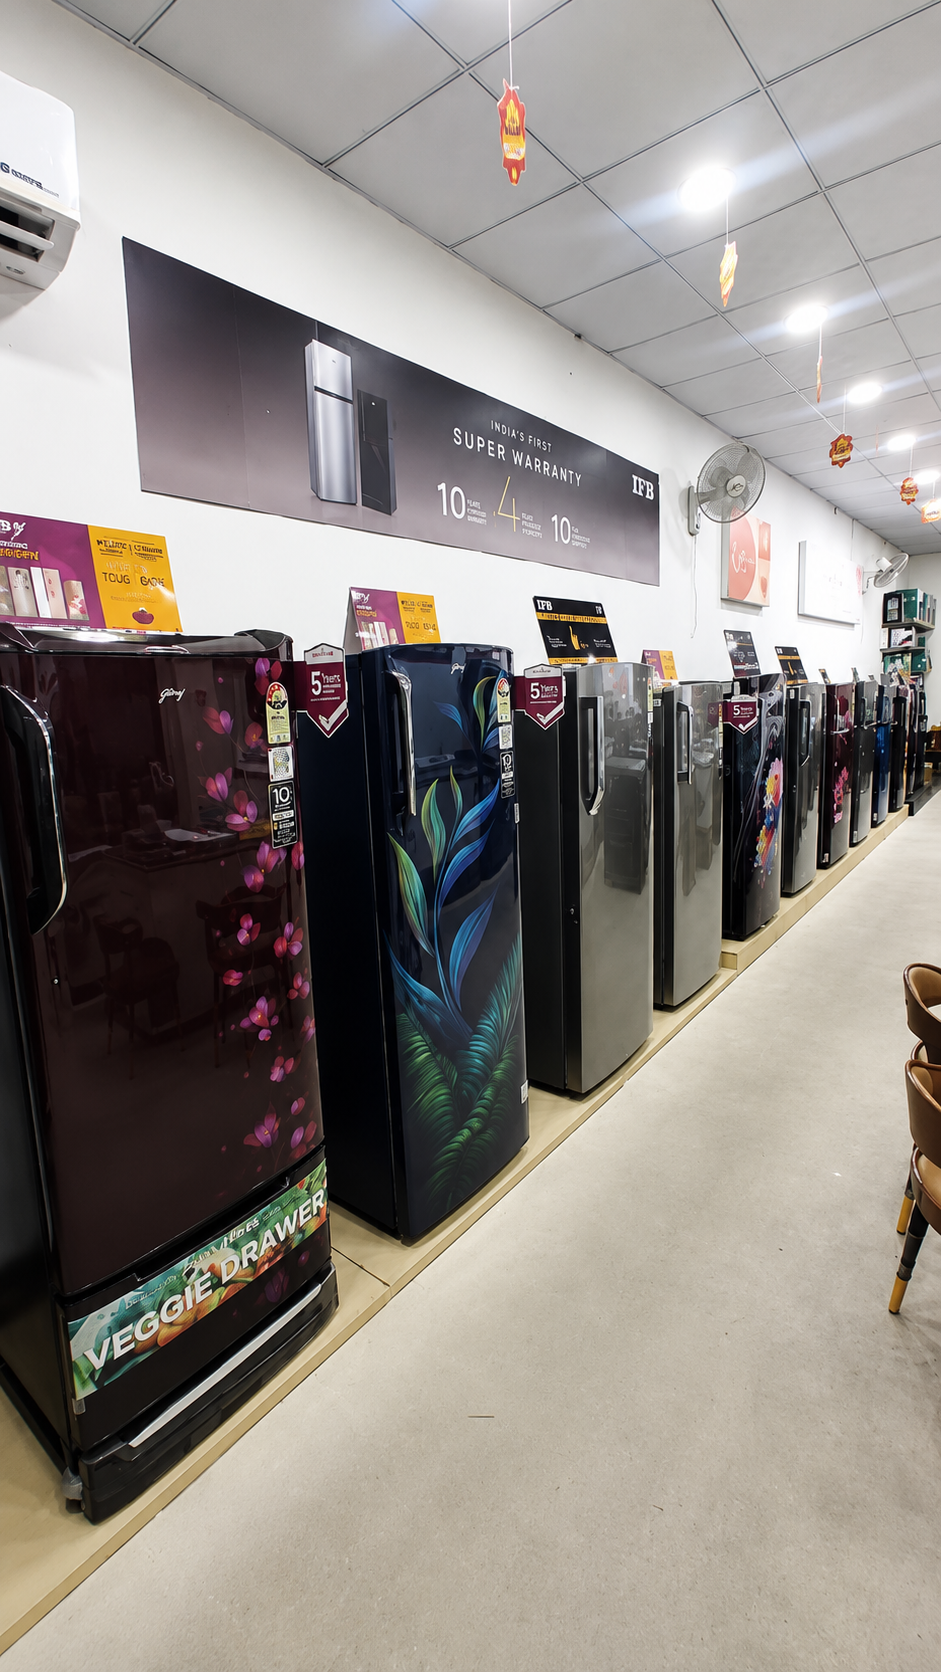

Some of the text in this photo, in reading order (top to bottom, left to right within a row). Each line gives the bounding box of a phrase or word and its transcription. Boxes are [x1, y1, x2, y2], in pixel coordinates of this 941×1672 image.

[490, 419, 552, 453] INDIA'S FIRST
[453, 427, 582, 487] SUPER WARRANTY
[437, 482, 466, 519] 10
[631, 474, 655, 501] IFB
[497, 476, 521, 532] 4
[551, 514, 571, 544] 10
[311, 671, 322, 696] 5
[530, 682, 541, 699] 5
[733, 704, 741, 716] 5
[272, 787, 290, 805] 10
[83, 1271, 213, 1371] VEGGIE
[220, 1187, 326, 1285] DRAWER
